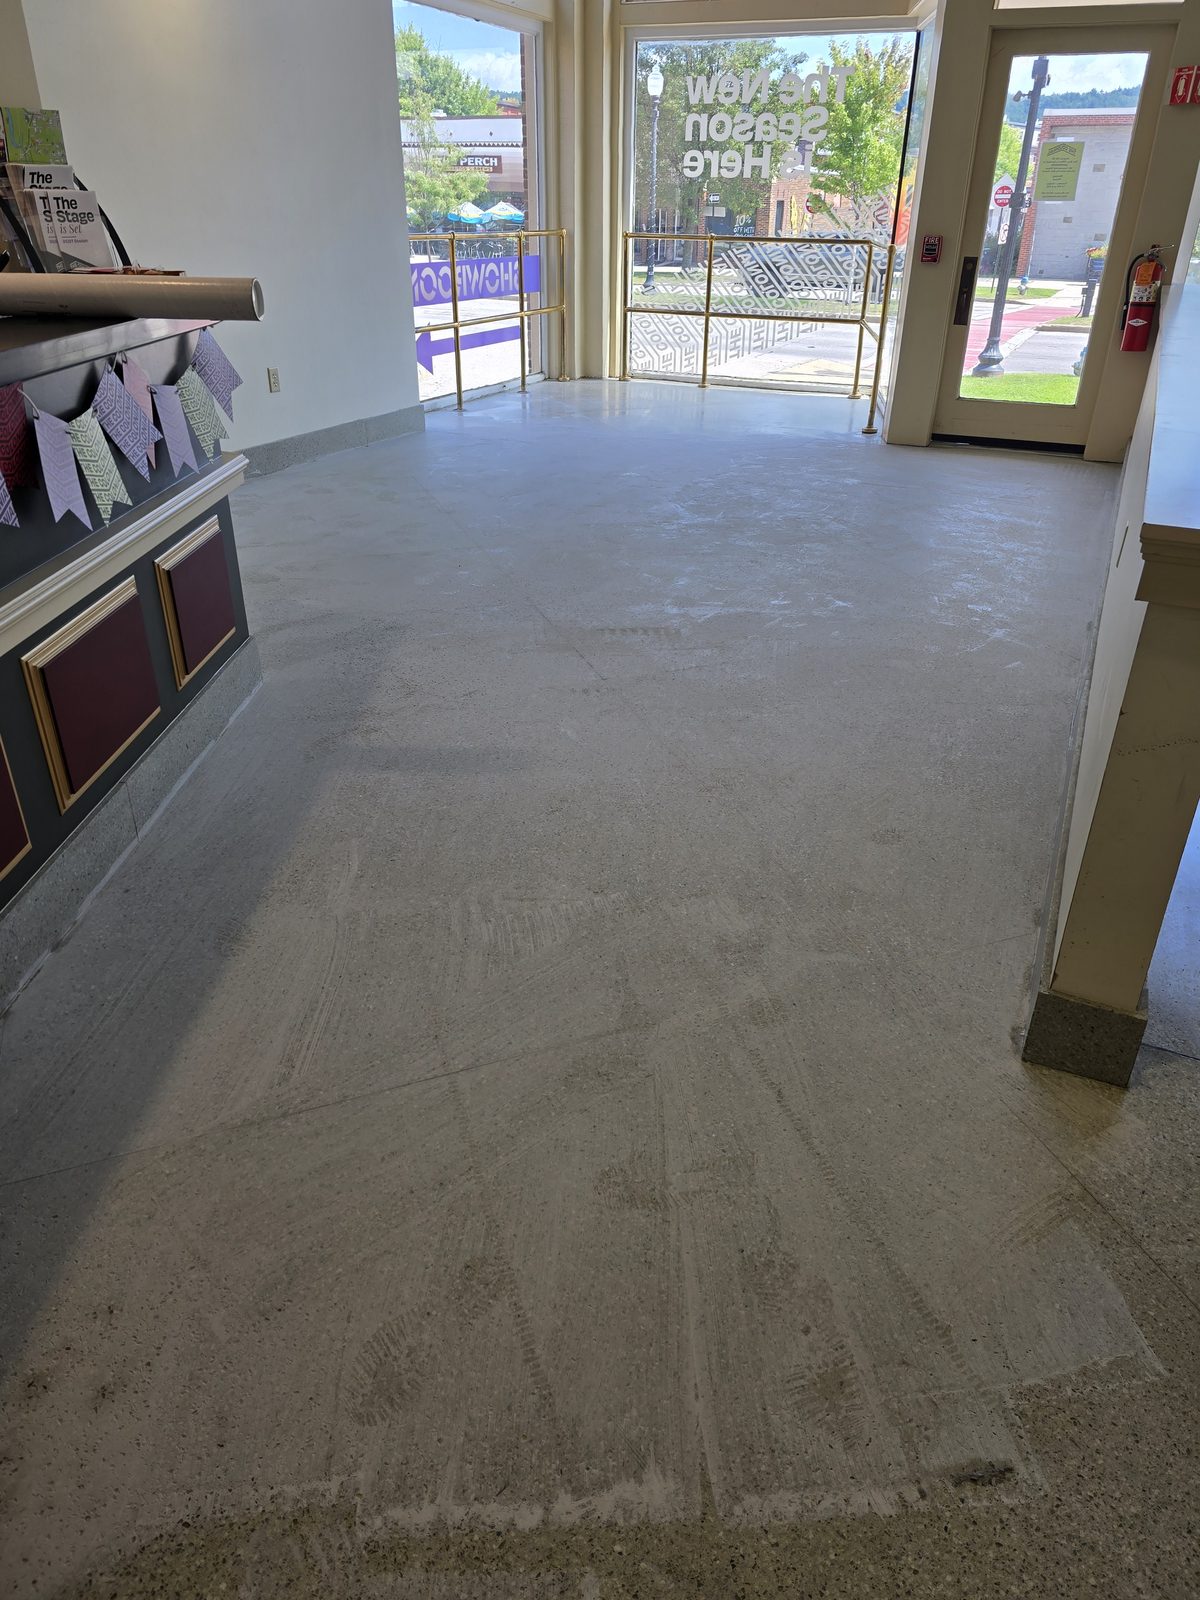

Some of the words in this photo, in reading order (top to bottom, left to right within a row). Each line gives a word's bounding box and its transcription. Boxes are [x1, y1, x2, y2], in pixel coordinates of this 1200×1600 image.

[460, 157, 498, 167] PERCH
[29, 171, 53, 184] The
[53, 196, 78, 210] The
[57, 210, 95, 225] Stage
[60, 223, 67, 234] is
[924, 236, 940, 244] FIRE
